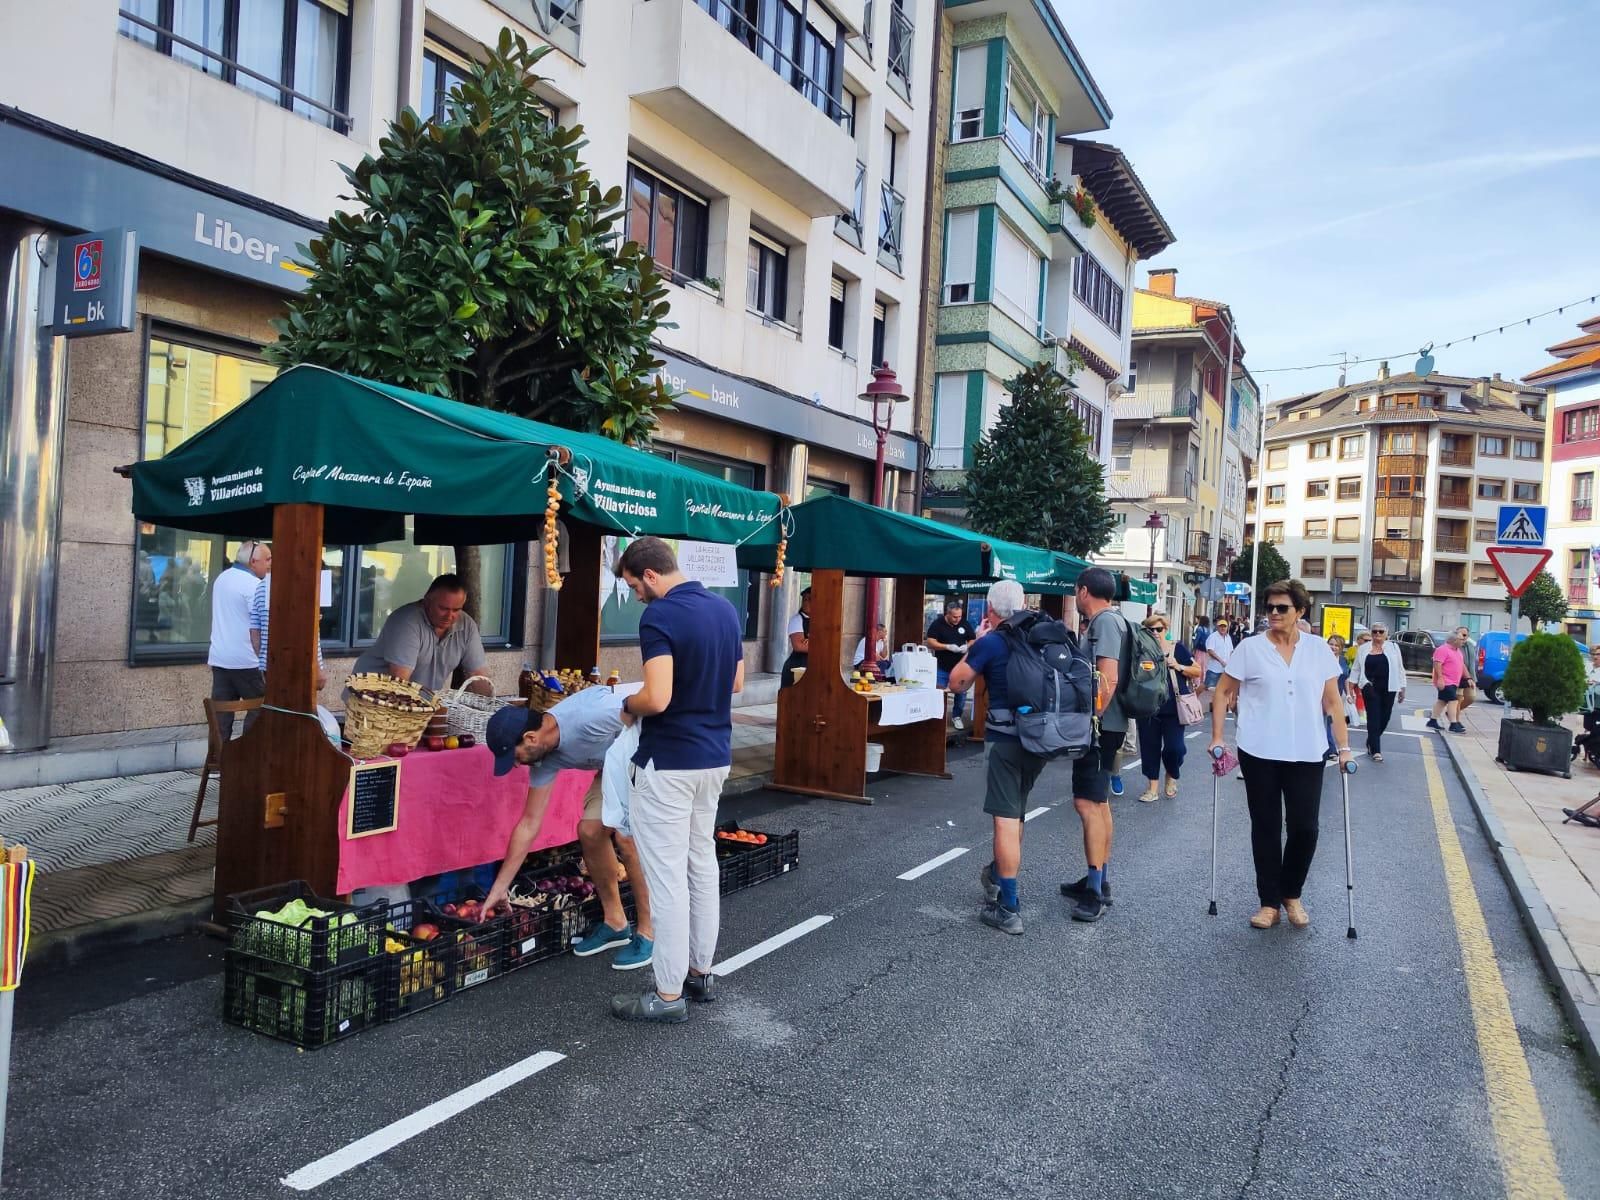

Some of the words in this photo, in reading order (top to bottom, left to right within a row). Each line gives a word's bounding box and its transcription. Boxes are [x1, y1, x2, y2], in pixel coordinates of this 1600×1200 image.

[195, 212, 280, 265] Liber
[711, 384, 740, 409] bank
[211, 469, 254, 486] Ayuntamiento
[254, 466, 263, 476] de
[324, 466, 381, 485] Manzanera
[383, 471, 394, 485] de
[397, 471, 432, 492] España
[210, 482, 263, 502] Villaviciosa
[594, 479, 646, 499] Ayuntamiento
[646, 489, 657, 500] de
[593, 493, 658, 517] Villaviciosa
[685, 498, 712, 517] Capital
